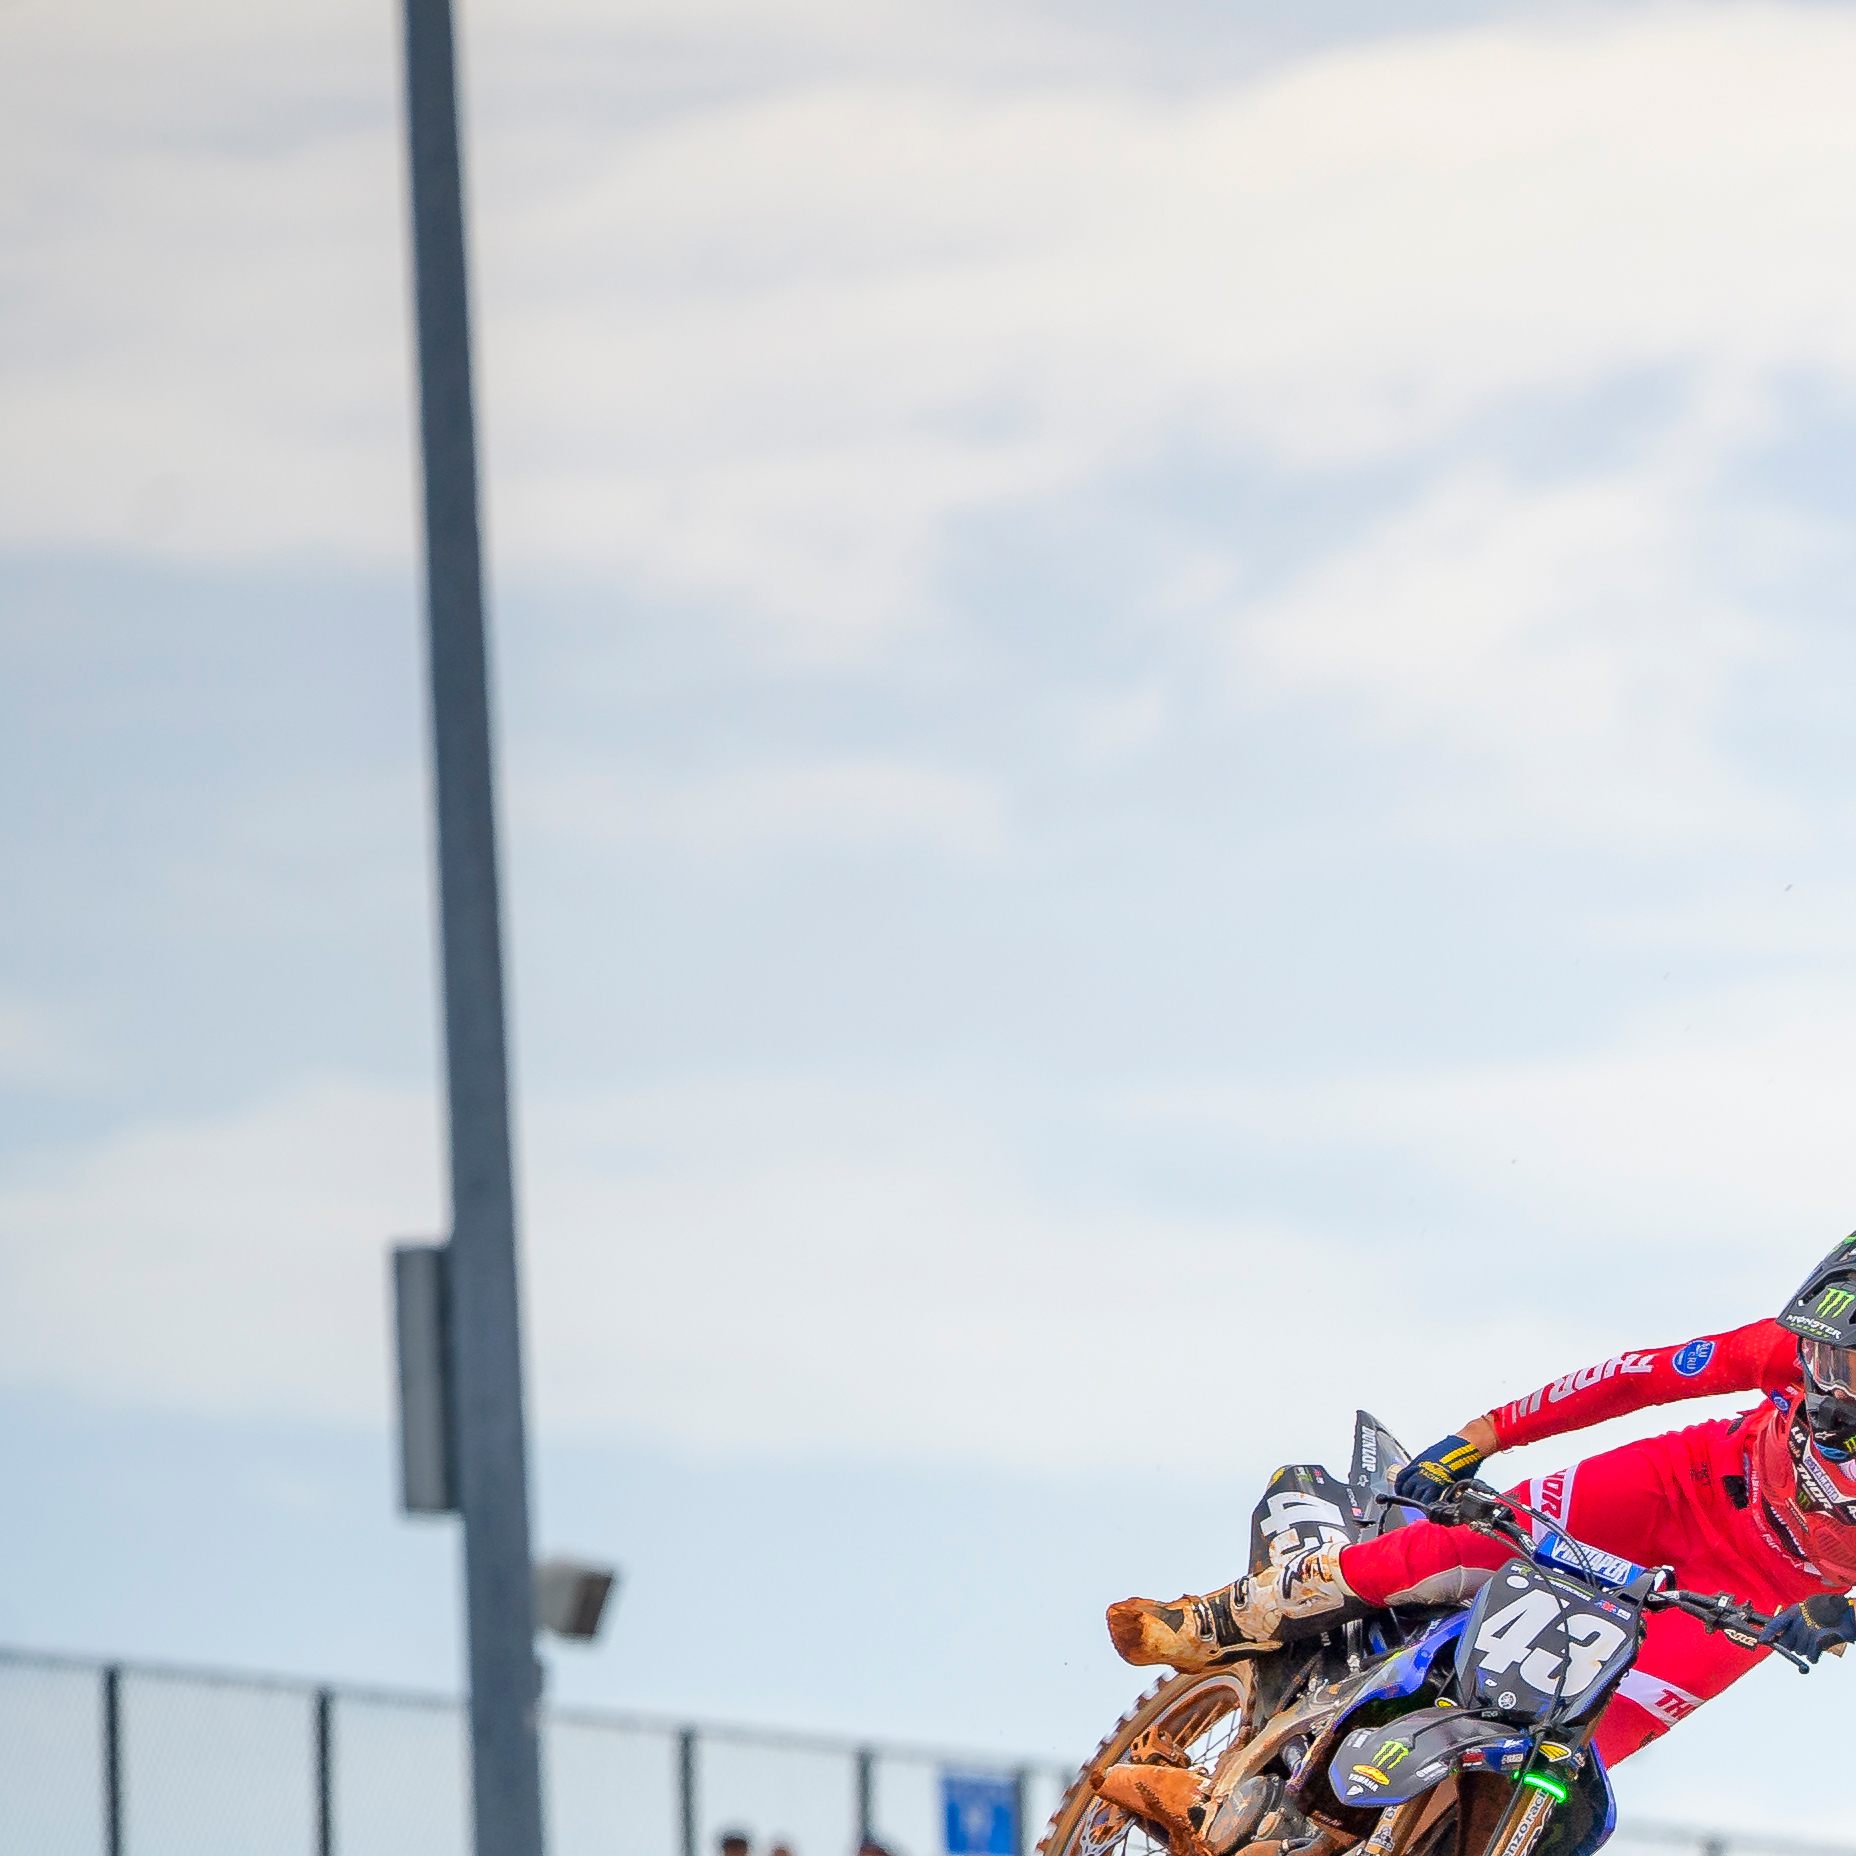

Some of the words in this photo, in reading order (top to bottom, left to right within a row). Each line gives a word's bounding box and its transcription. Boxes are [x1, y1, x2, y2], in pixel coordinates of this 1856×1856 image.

[1786, 1314, 1842, 1341] MONSTER
[1361, 1425, 1378, 1473] DUNLOP
[1796, 1463, 1833, 1511] THOR
[1474, 1588, 1628, 1698] 43
[1348, 1773, 1380, 1793] YAMAHA
